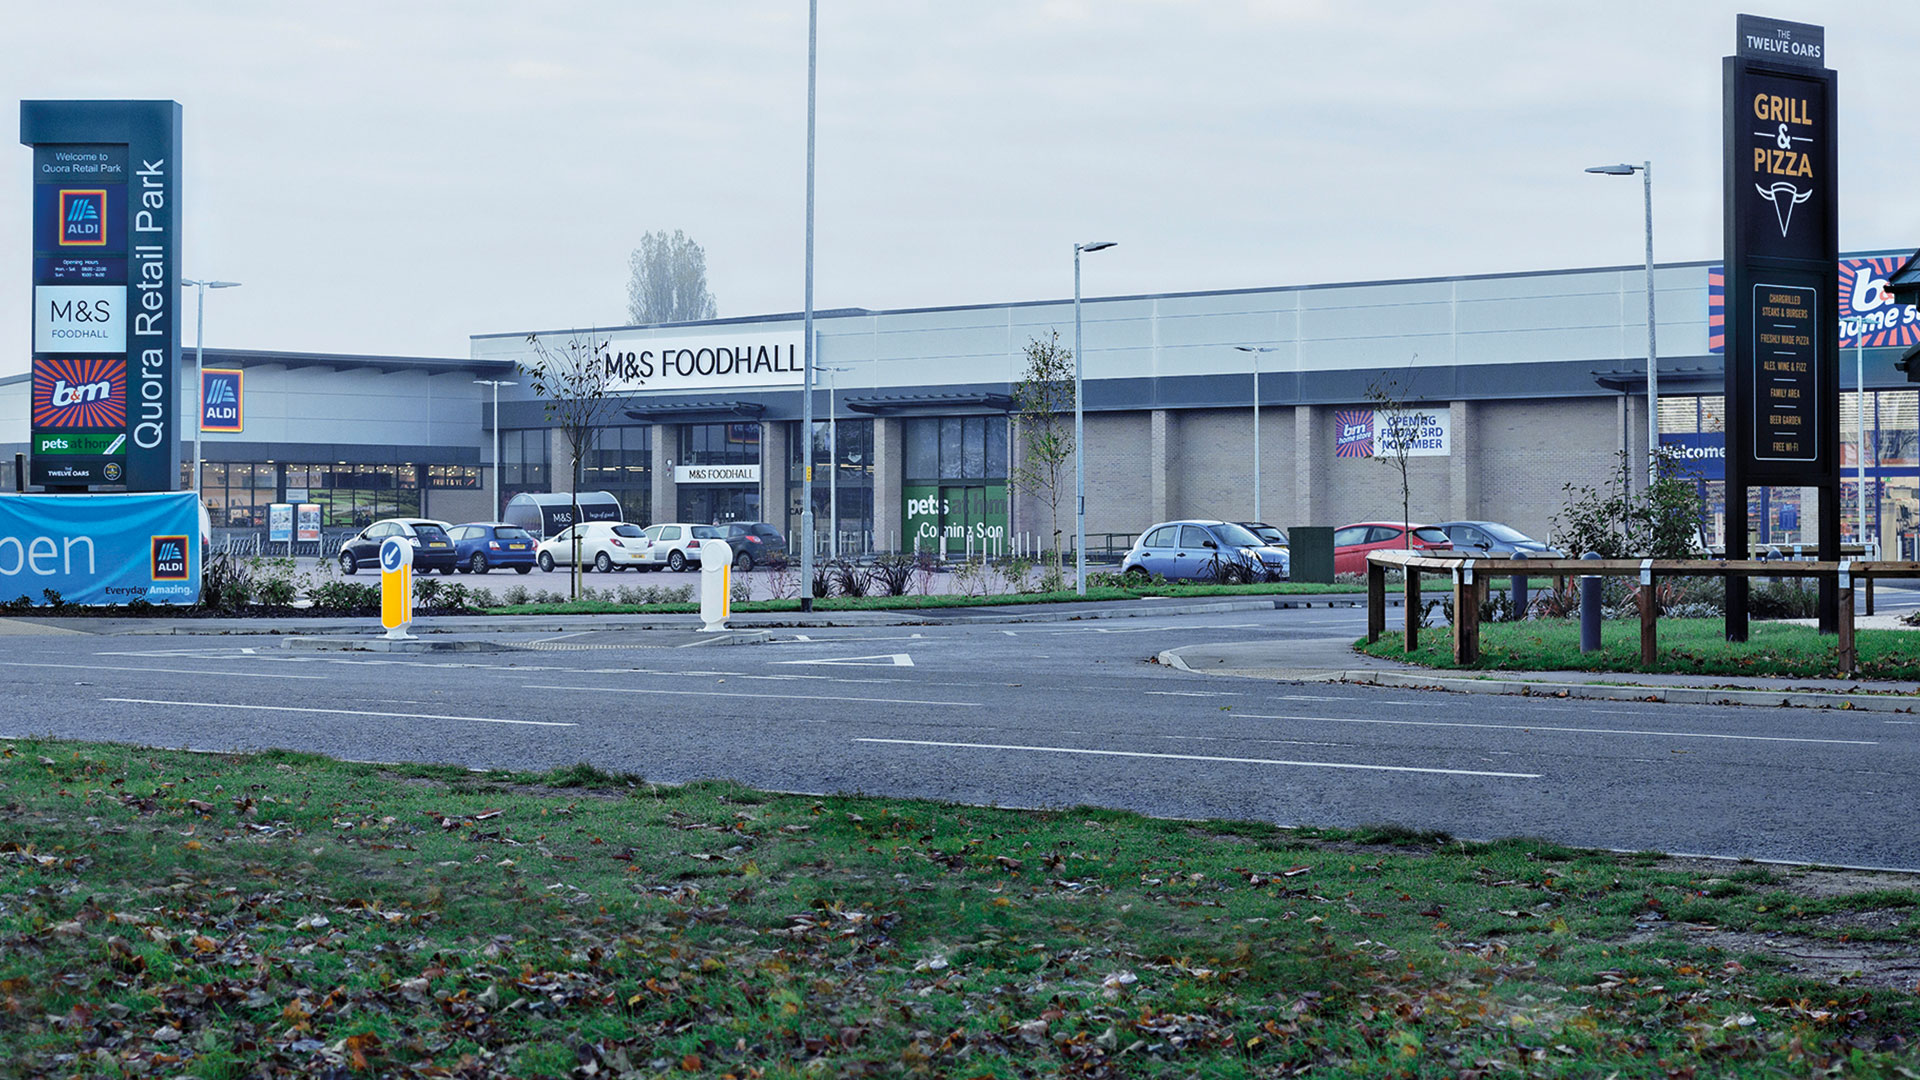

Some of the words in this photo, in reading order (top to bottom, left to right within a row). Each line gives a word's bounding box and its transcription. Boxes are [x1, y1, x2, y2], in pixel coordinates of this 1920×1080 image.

[1777, 29, 1791, 40] THE
[1746, 35, 1789, 54] TWELVE
[1791, 42, 1821, 58] OARS
[1754, 93, 1812, 126] GRILL
[1777, 123, 1791, 150] &
[55, 152, 97, 161] Welcome
[99, 152, 109, 161] to
[1754, 147, 1813, 178] PIZZA
[42, 164, 70, 173] Quora
[72, 164, 98, 173] Retail
[100, 164, 122, 173] Park
[135, 159, 164, 232] Park
[67, 224, 99, 234] ALDI
[135, 245, 163, 335] Retail
[1769, 293, 1801, 305] CHARGRILLED
[51, 300, 110, 322] M&S
[1762, 306, 1780, 317] STEAKS
[1781, 308, 1785, 317] &
[1786, 308, 1808, 319] BURGERS
[51, 329, 109, 338] FOODHALL
[1760, 333, 1780, 344] FRESHLY
[1781, 335, 1795, 345] MADE
[1795, 335, 1810, 346] PIZZA
[604, 350, 654, 380] M&S
[662, 344, 804, 377] FOODHALL
[1778, 362, 1790, 371] WINE
[1796, 362, 1807, 372] FIZZ
[133, 349, 164, 449] Quora
[1770, 387, 1787, 398] FAMILY
[1788, 388, 1800, 399] AREA
[206, 407, 236, 419] ALDI
[1387, 415, 1437, 427] OPENING
[1769, 415, 1782, 425] BEER
[1782, 415, 1802, 425] GARDEN
[1421, 427, 1444, 438] 3RD
[42, 438, 69, 451] pets
[70, 438, 83, 449] at
[1381, 438, 1443, 450] NOVEMBER
[1772, 442, 1785, 452] FREE
[1785, 442, 1799, 452] WI-FI
[689, 469, 707, 479] M&S
[708, 468, 753, 480] FOODHALL
[553, 512, 573, 523] M&S
[158, 562, 184, 572] ALDI
[105, 585, 149, 597] Everyday
[150, 584, 193, 596] Amazing.
